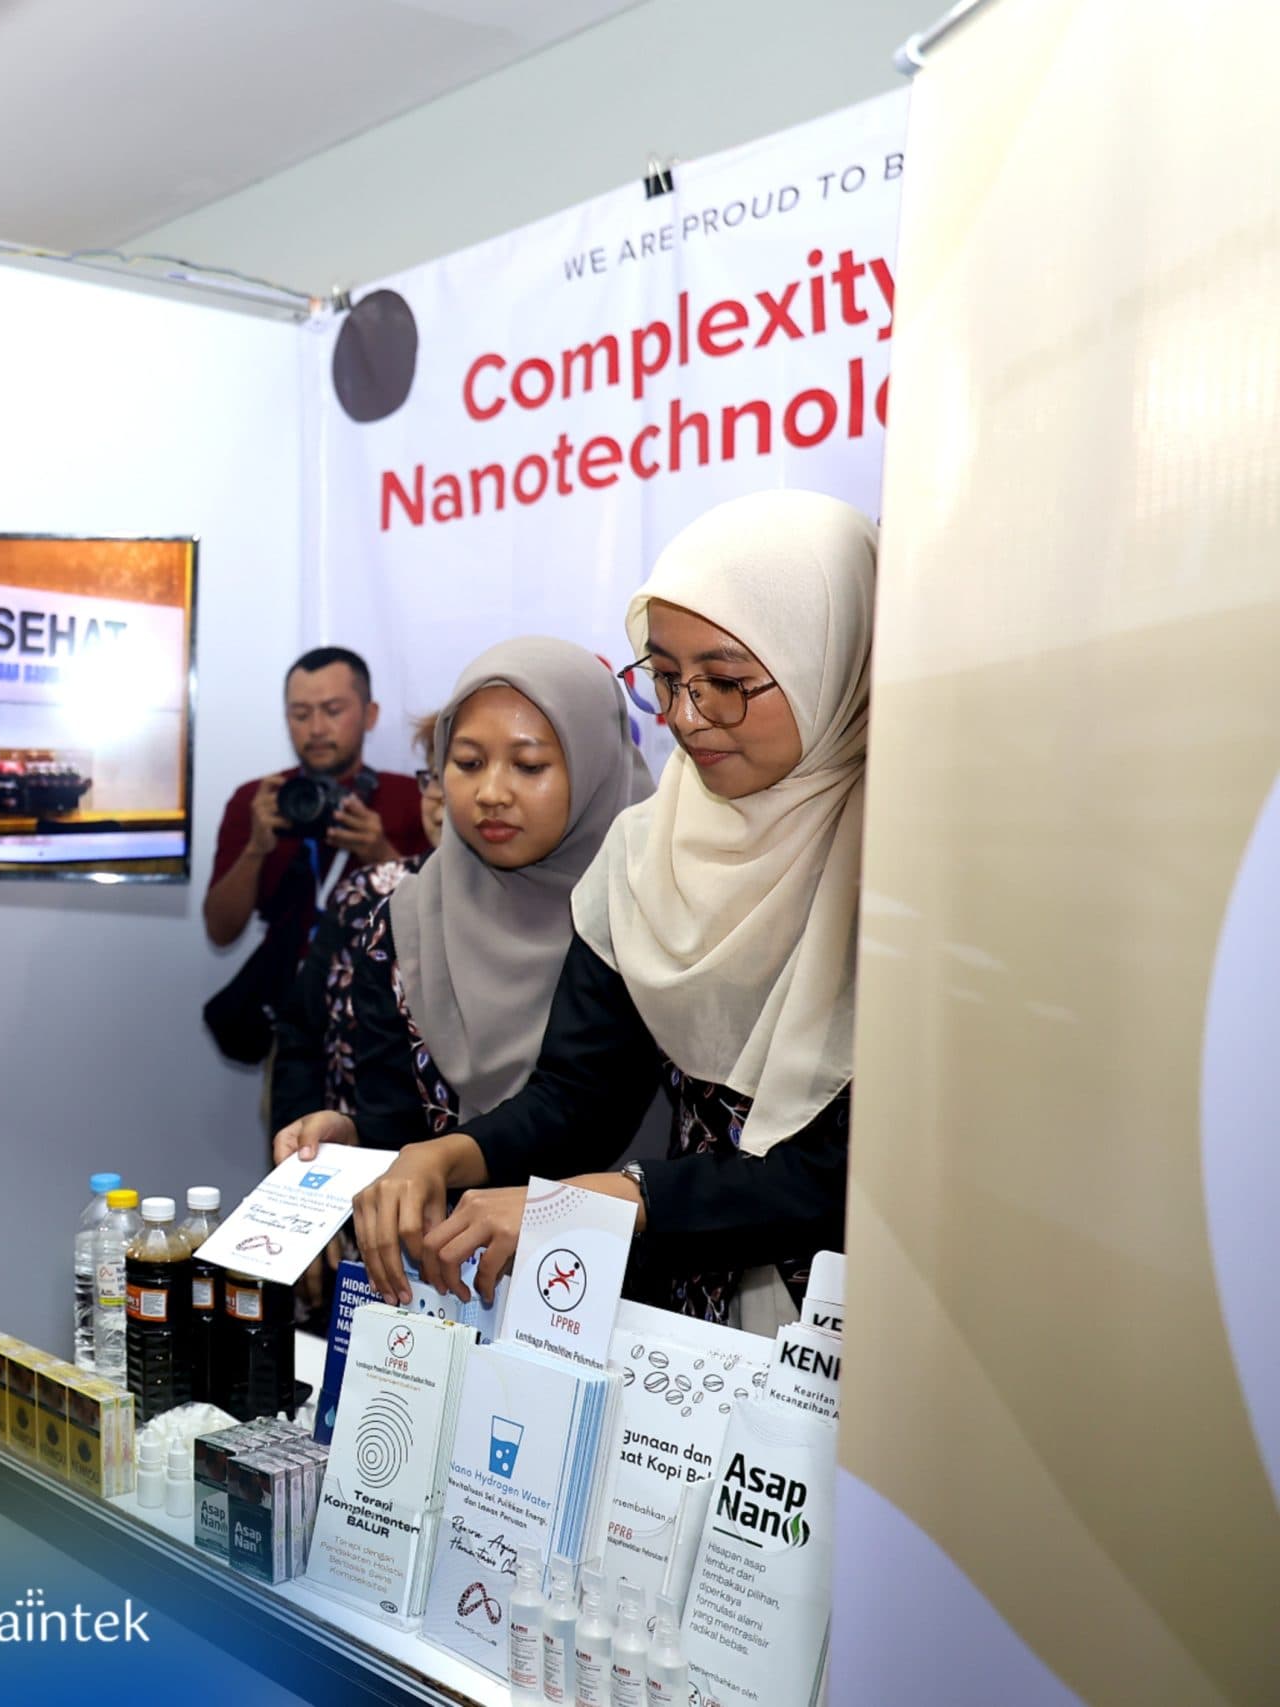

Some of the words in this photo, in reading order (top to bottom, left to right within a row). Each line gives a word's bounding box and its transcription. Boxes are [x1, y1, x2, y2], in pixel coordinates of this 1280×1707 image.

[564, 248, 608, 282] WE
[619, 225, 675, 264] ARE
[682, 185, 801, 242] PROUD
[819, 165, 867, 200] TO
[883, 152, 906, 181] B
[462, 248, 896, 423] Complexity
[549, 1312, 581, 1336] LPPRB
[812, 1312, 843, 1332] KE
[770, 1388, 830, 1417] Kecanggihan
[794, 1384, 835, 1406] Kearifan
[623, 1429, 678, 1455] gunaan
[683, 1443, 712, 1466] dan
[647, 1454, 682, 1480] Kopi
[475, 1469, 519, 1496] Hydrogen
[521, 1488, 551, 1510] Water
[724, 1452, 807, 1513] Asap
[200, 1500, 226, 1521] Asap
[234, 1521, 262, 1544] Asap
[346, 1515, 390, 1538] BALUR
[608, 1521, 633, 1540] PPRB
[705, 1554, 735, 1574] lembut
[736, 1568, 755, 1582] dari
[708, 1541, 742, 1562] Hisapan
[744, 1557, 766, 1574] asap
[699, 1581, 742, 1607] diperkaya
[702, 1568, 746, 1594] tembakau
[693, 1608, 714, 1626] yang
[696, 1593, 736, 1619] formulasi
[737, 1614, 763, 1631] alami
[689, 1621, 718, 1640] radikal
